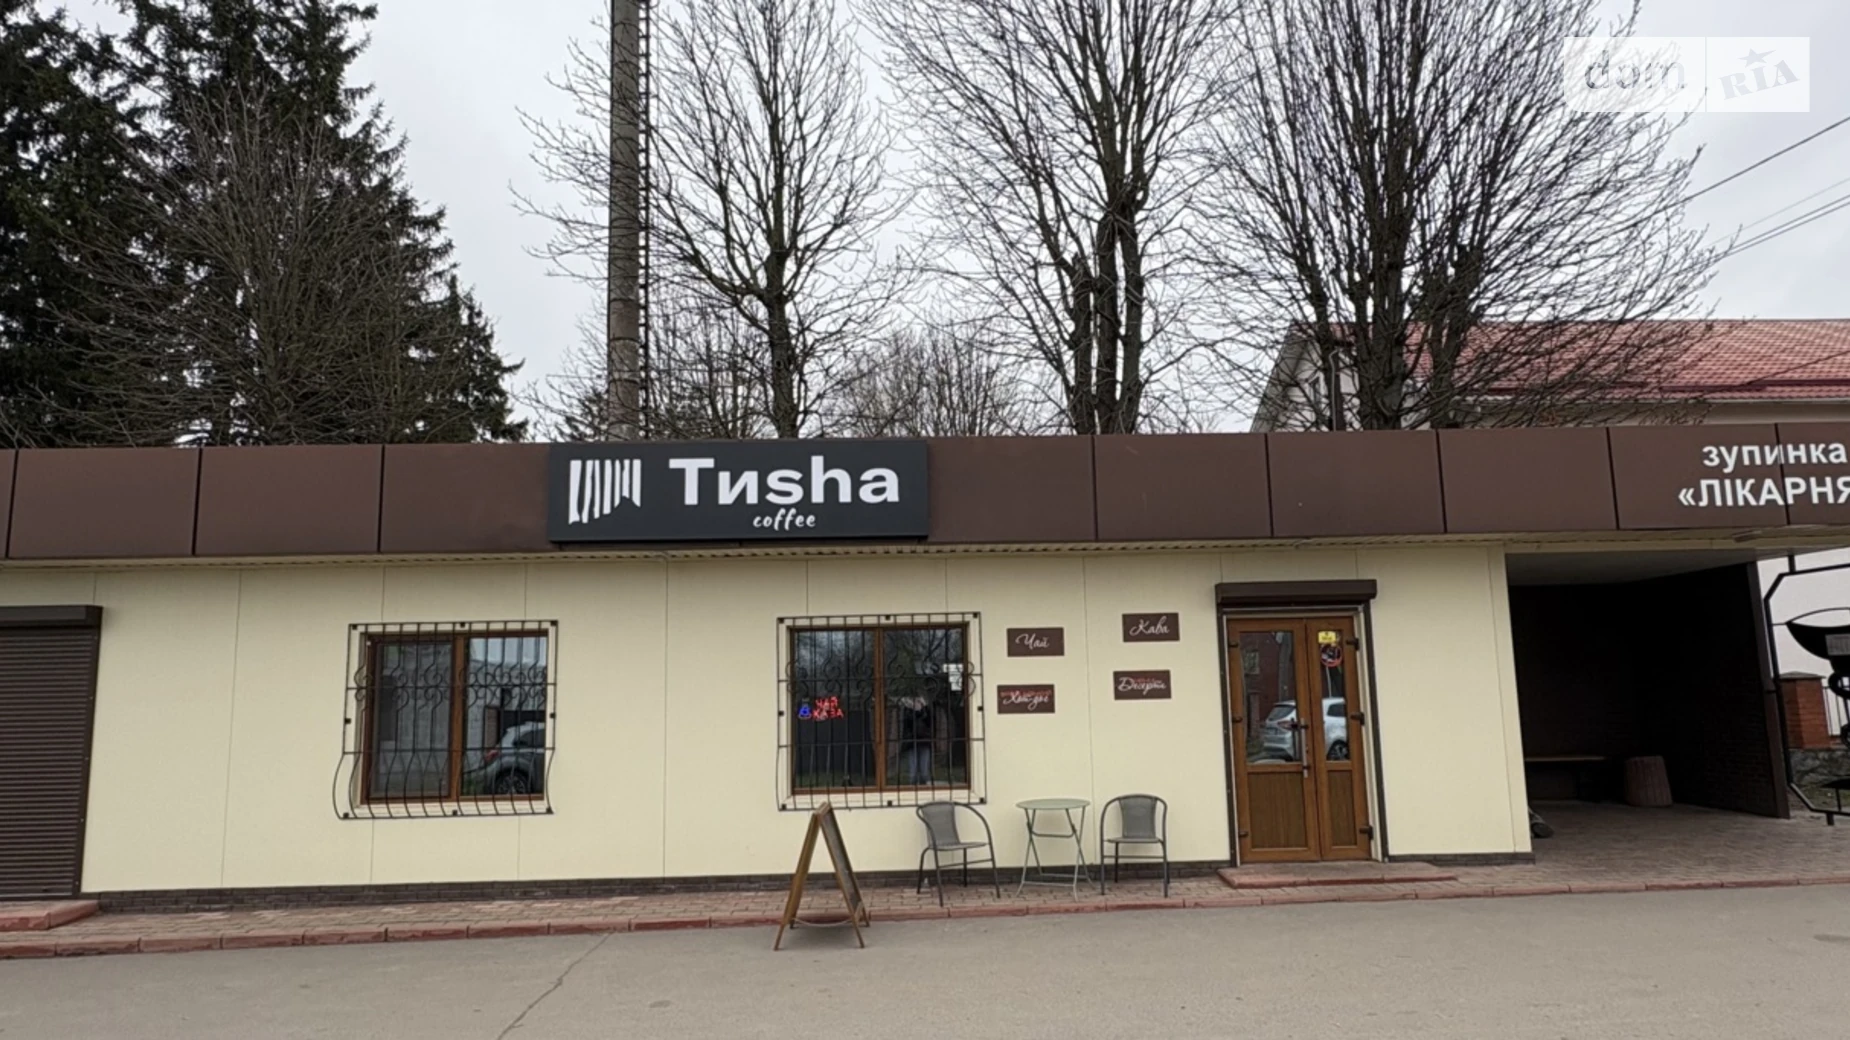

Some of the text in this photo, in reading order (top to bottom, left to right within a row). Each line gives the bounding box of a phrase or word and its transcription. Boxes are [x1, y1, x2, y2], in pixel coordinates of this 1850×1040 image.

[1702, 442, 1848, 473] зупинка
[752, 507, 816, 532] coffee
[1129, 616, 1169, 636] Кава
[1015, 633, 1049, 650] Чай
